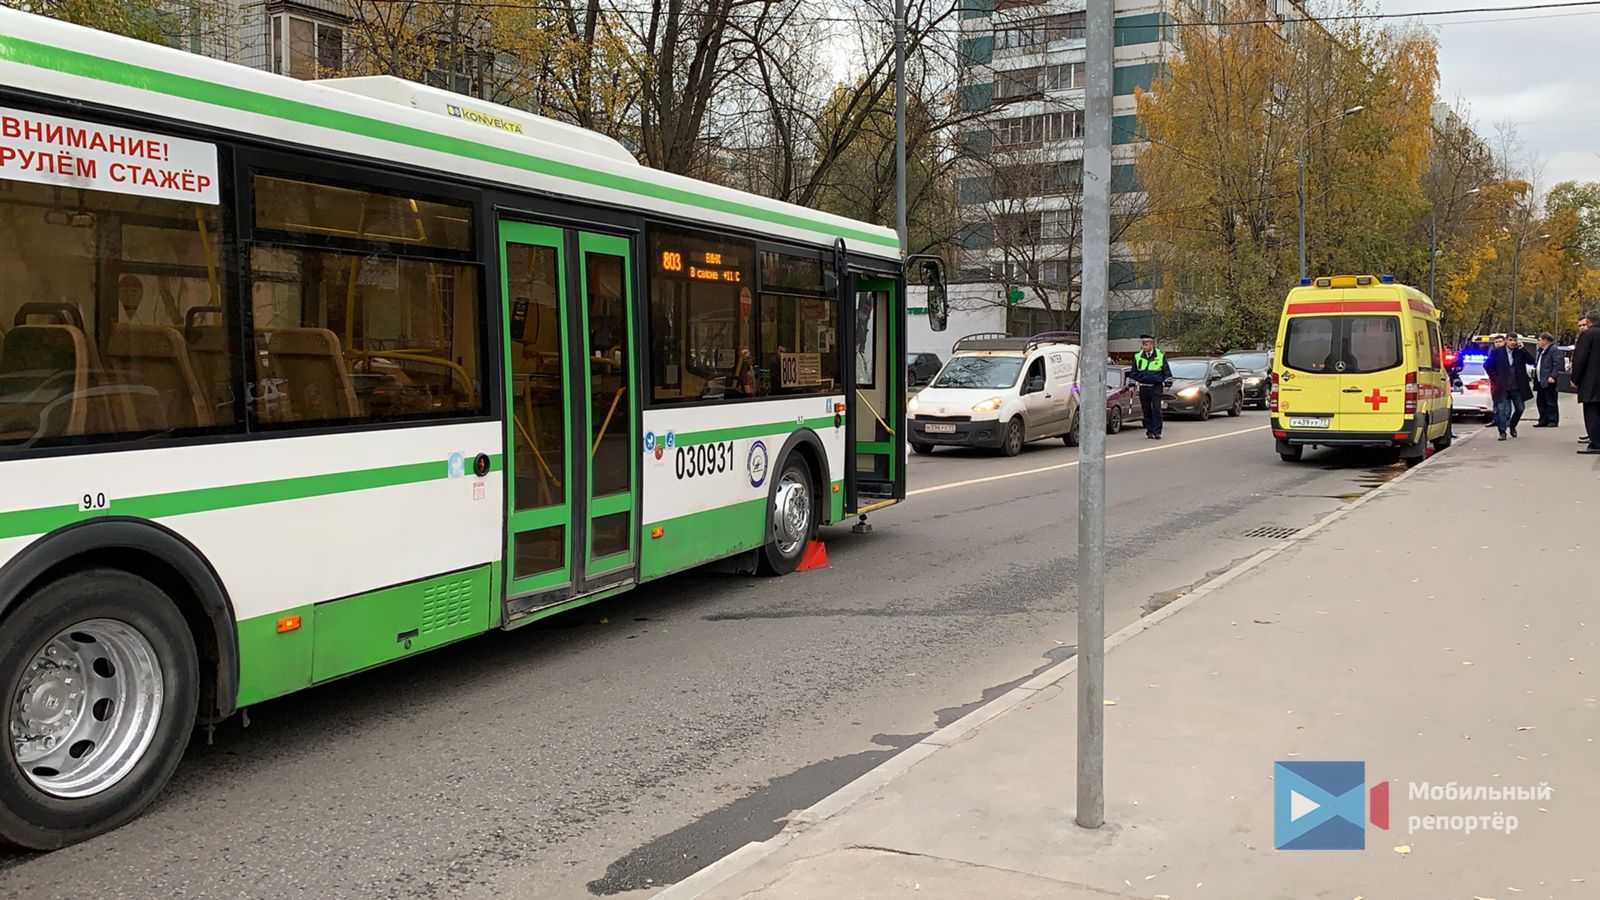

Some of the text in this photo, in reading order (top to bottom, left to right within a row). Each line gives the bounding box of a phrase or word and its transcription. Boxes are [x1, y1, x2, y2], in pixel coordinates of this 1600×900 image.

[461, 108, 523, 134] KONVEKTA
[1, 116, 170, 162] ВНИМАНИЕ!
[0, 146, 212, 194] РУЛЁМ СТАЖЁР
[662, 251, 682, 271] 803
[675, 440, 735, 480] 030931
[82, 492, 106, 510] 9.0
